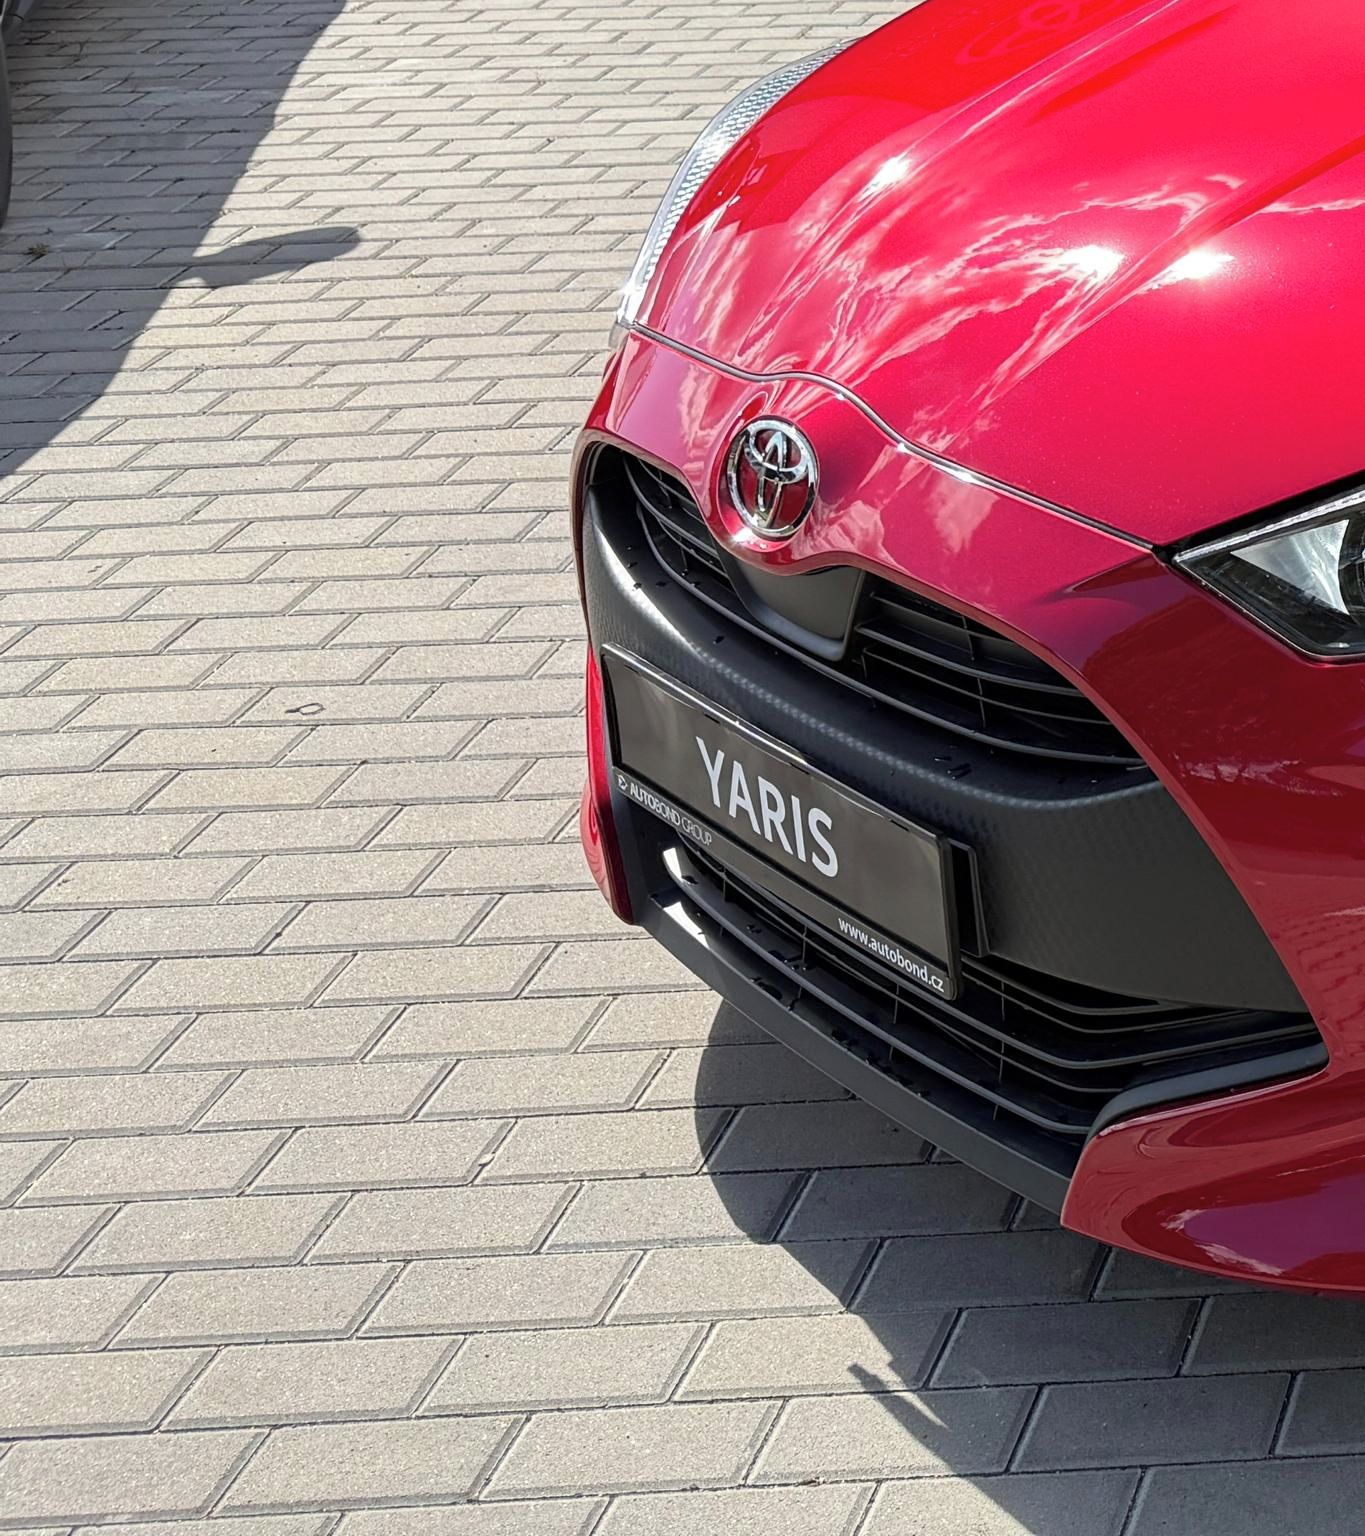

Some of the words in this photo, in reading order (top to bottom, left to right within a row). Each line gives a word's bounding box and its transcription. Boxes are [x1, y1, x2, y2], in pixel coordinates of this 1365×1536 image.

[630, 782, 681, 826] AUTOBOND
[681, 816, 713, 845] GROUP
[695, 736, 840, 878] YARIS
[838, 917, 946, 993] www.autobond.cz
